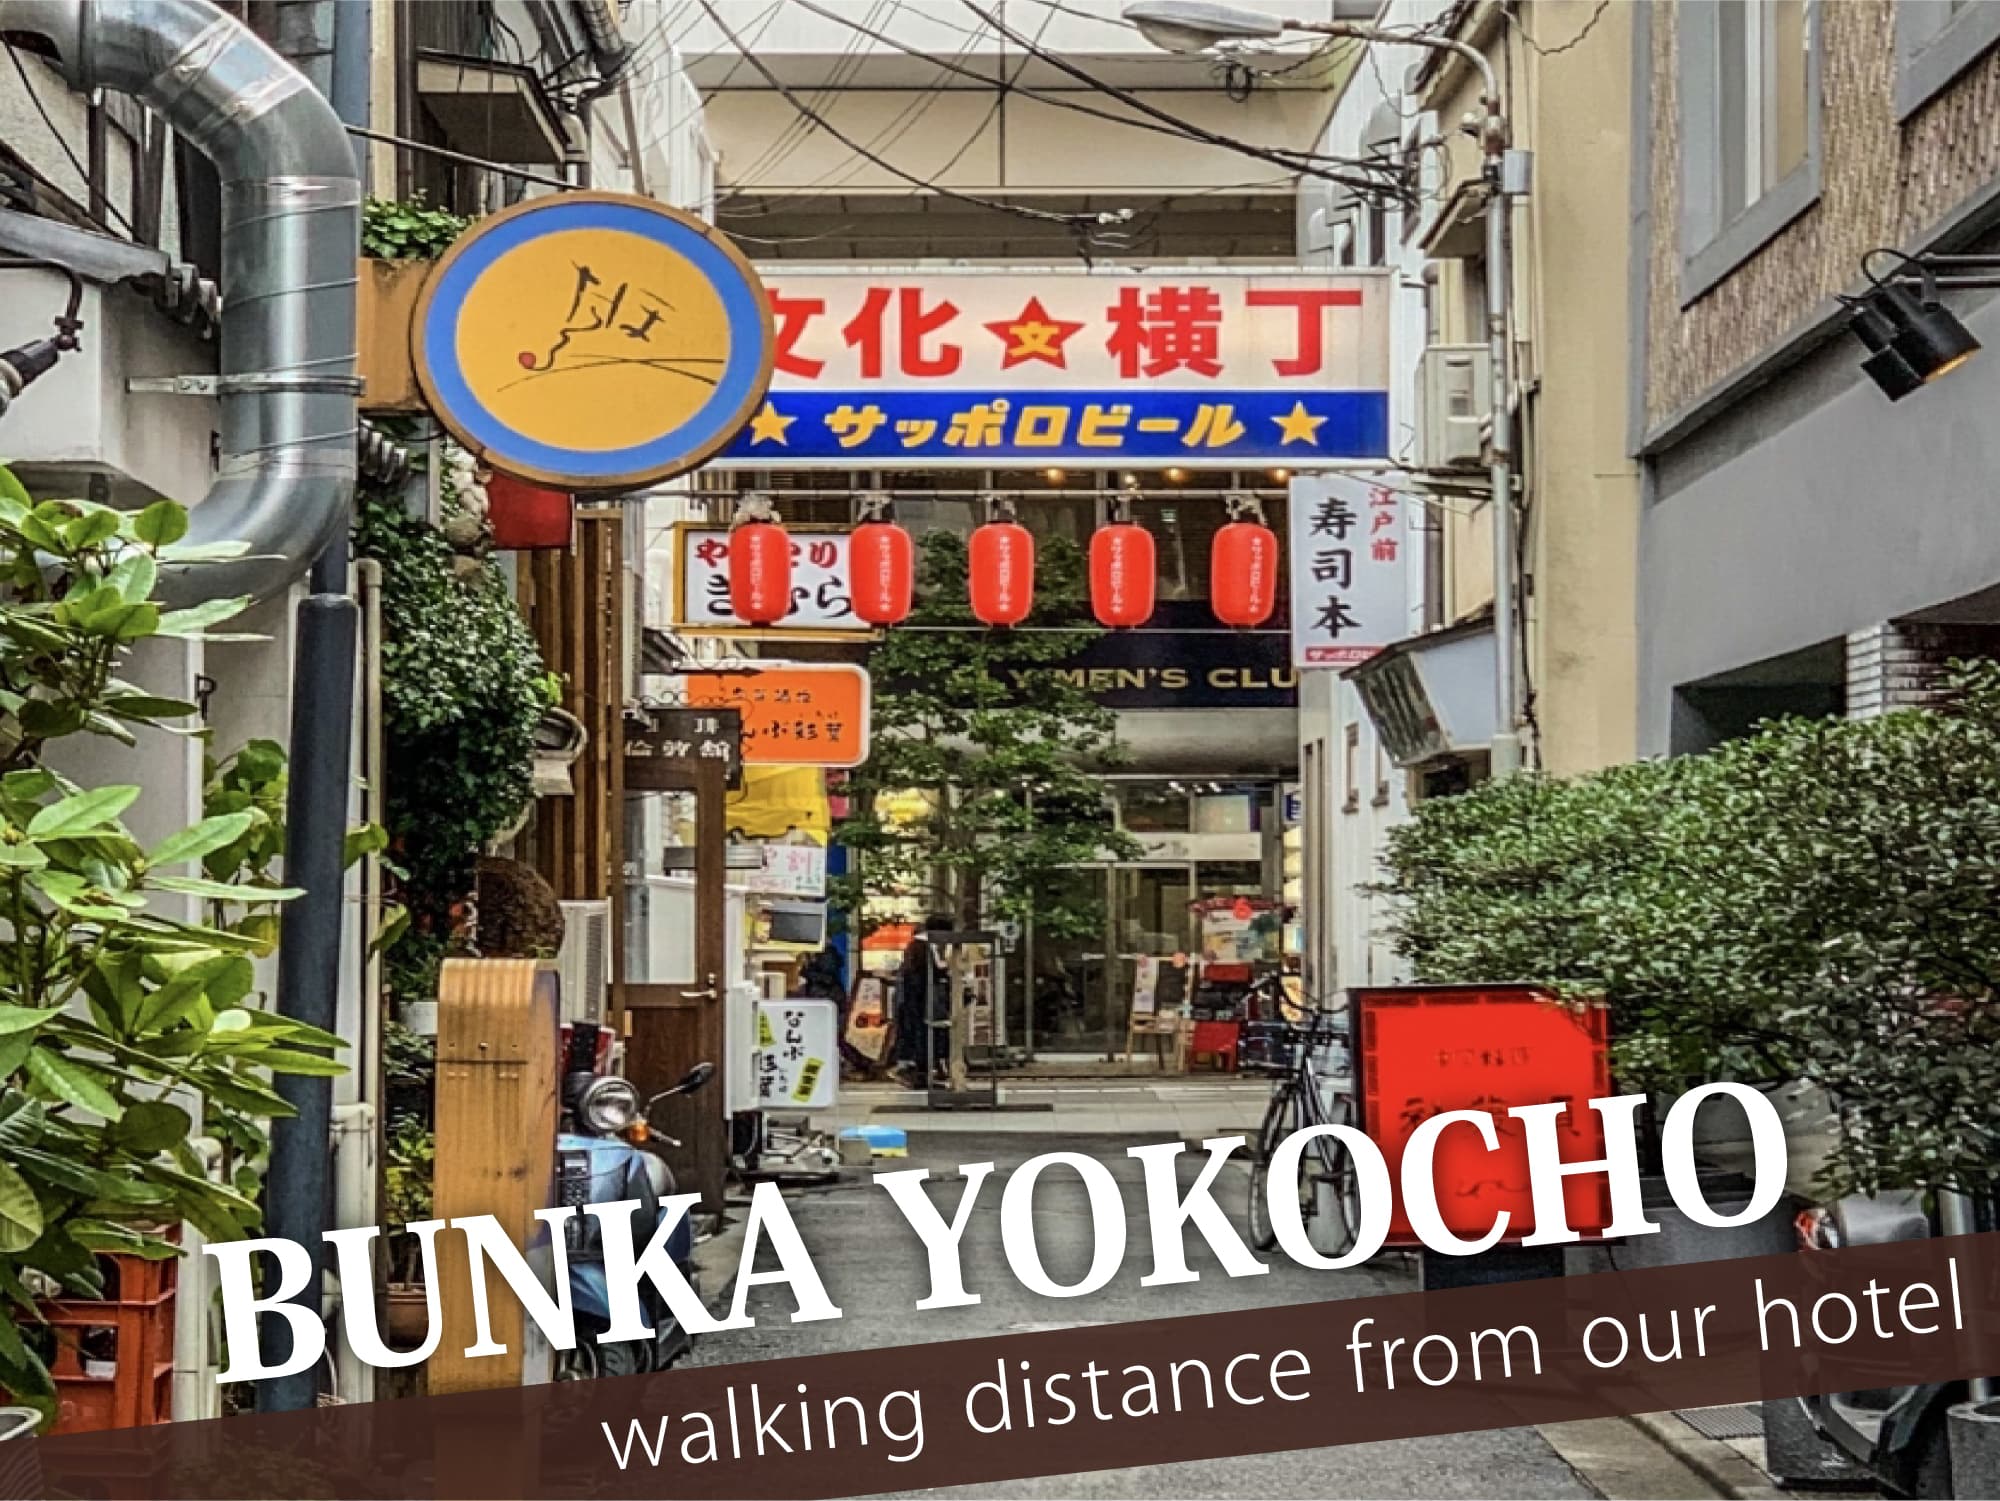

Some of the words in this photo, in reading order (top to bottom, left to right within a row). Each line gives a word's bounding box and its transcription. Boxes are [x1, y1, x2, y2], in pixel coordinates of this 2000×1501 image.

[1106, 287, 1361, 379] 横丁
[824, 400, 1244, 447] サッポロビール
[1370, 488, 1398, 561] 江戸前
[1309, 497, 1362, 639] 寿司本
